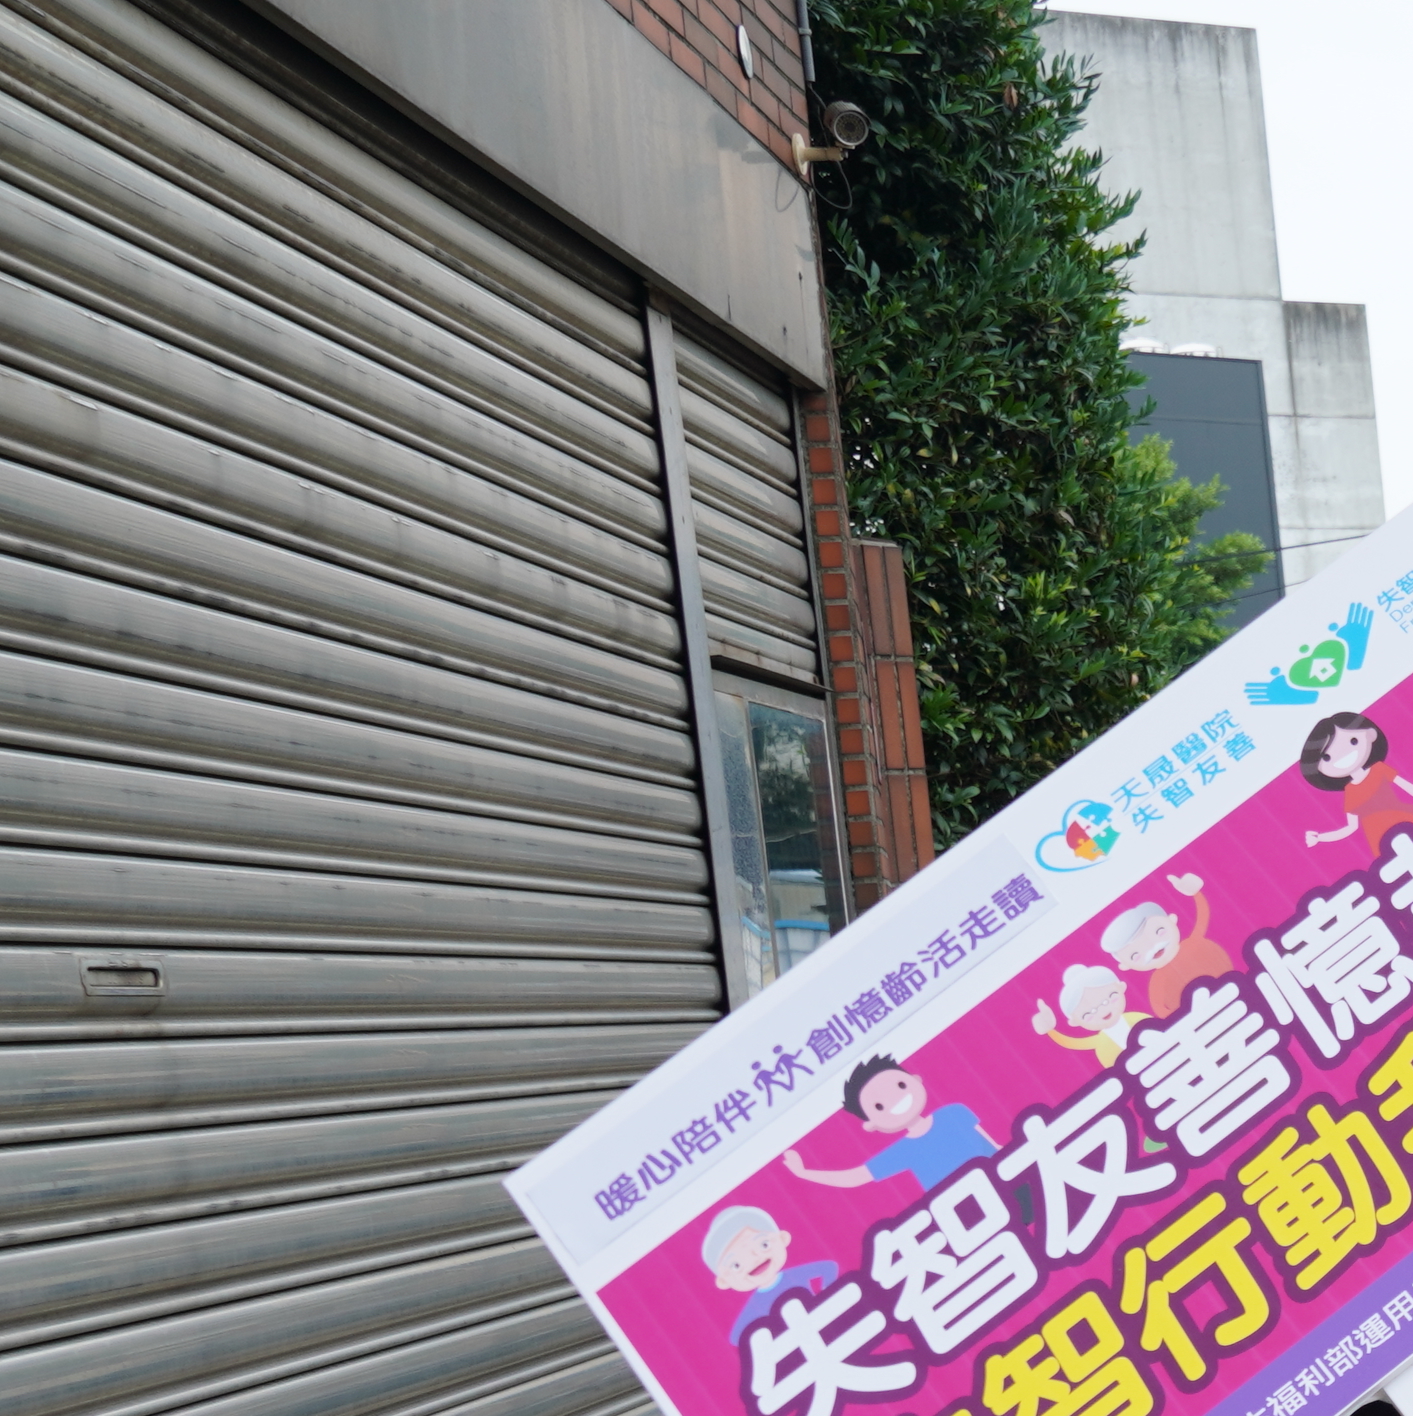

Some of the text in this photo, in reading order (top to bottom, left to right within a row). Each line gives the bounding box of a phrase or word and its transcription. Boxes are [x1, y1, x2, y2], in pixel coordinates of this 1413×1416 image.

[1110, 708, 1242, 813] 天晟醫院
[1130, 731, 1257, 834] 失智友善
[594, 873, 1045, 1221] 暖心陪伴 創憶齡活走讀
